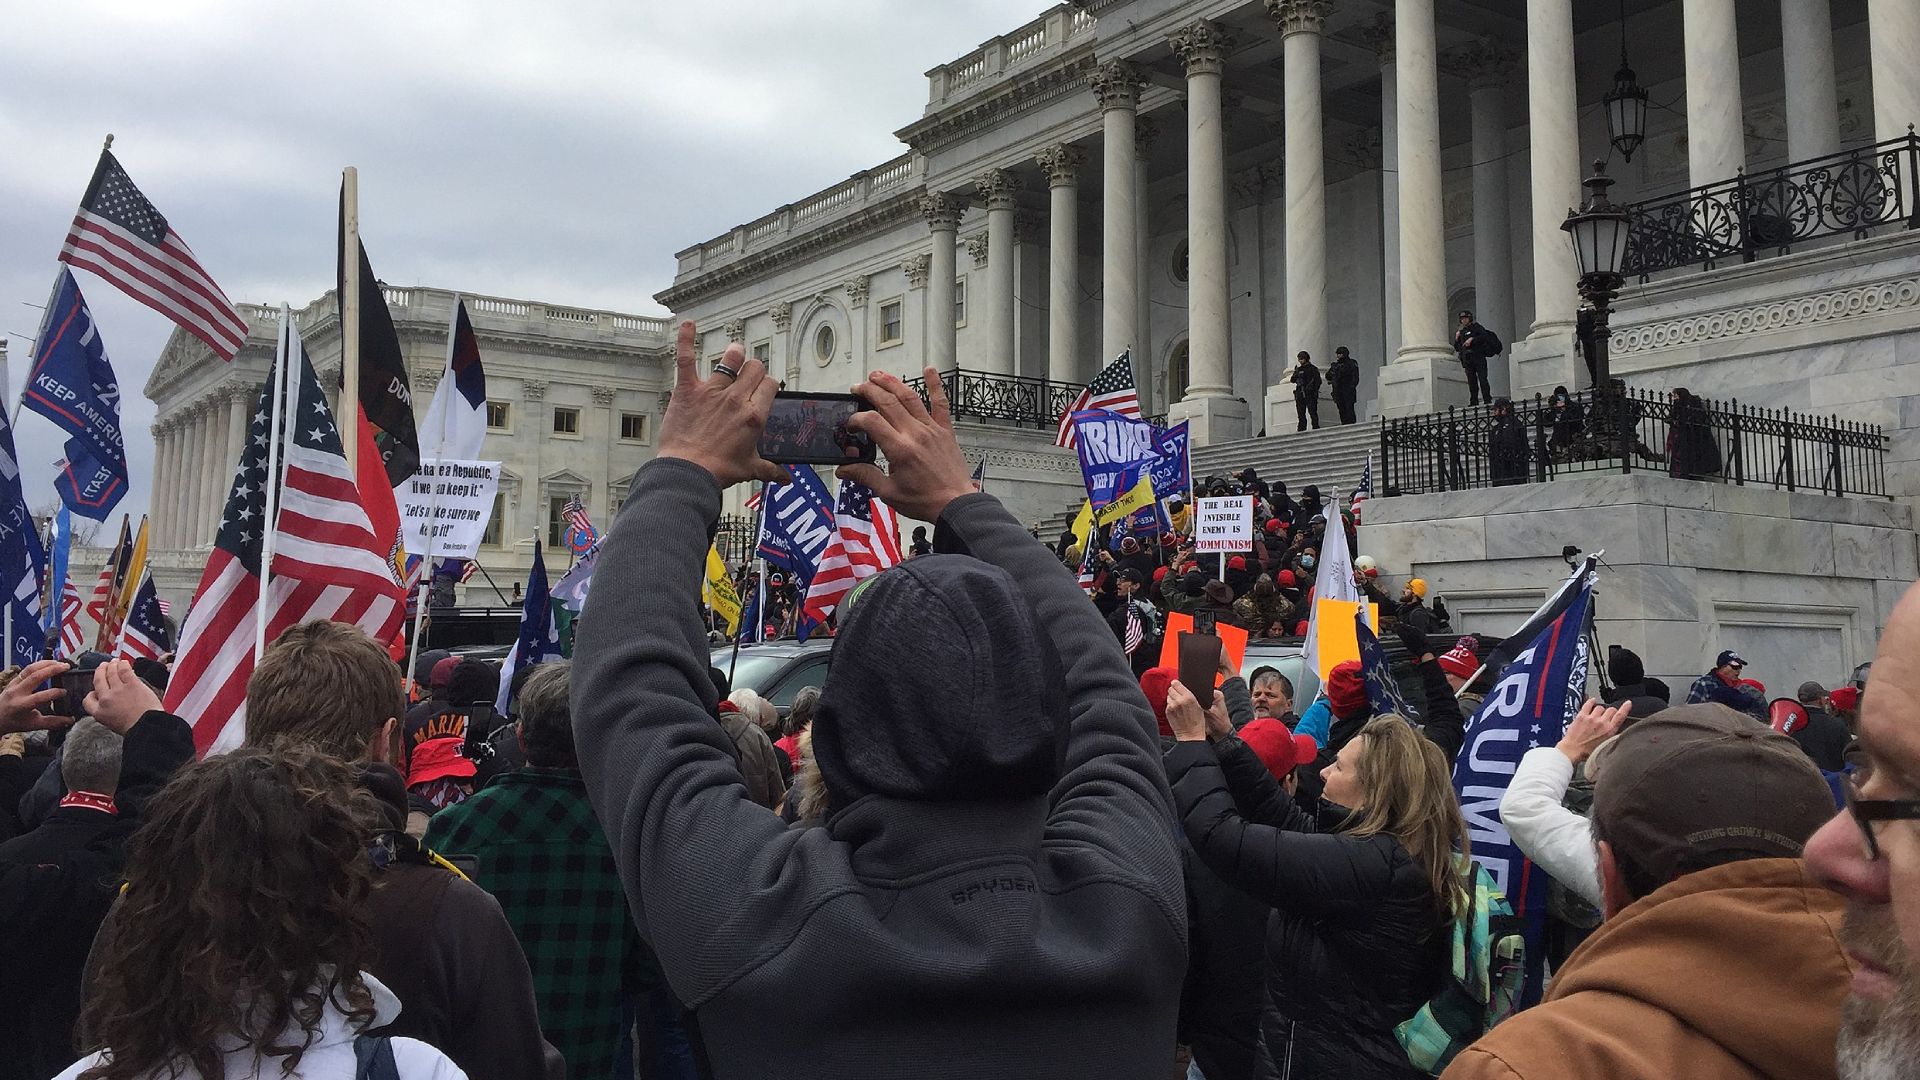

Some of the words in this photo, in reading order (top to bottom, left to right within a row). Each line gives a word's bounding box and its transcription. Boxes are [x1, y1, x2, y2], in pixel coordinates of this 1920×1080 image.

[388, 376, 413, 408] DON
[36, 373, 76, 401] KEEP
[75, 401, 124, 448] AMERIC
[414, 464, 422, 477] e
[423, 464, 445, 477] hae
[445, 465, 451, 477] a
[452, 464, 493, 480] Republic,
[412, 481, 420, 494] if
[420, 482, 431, 495] we
[446, 482, 469, 498] keep
[1203, 501, 1219, 510] THE
[1223, 500, 1244, 509] REAL
[425, 505, 447, 519] mke
[447, 508, 467, 521] sure
[466, 509, 481, 522] we
[1204, 513, 1241, 522] INVISIBLE
[419, 523, 439, 538] kep
[1202, 526, 1227, 534] ENEMY
[1232, 525, 1241, 534] IS
[1195, 540, 1252, 550] COMMUNISM
[413, 713, 465, 744] MARIN
[951, 878, 1037, 906] SPYDER
